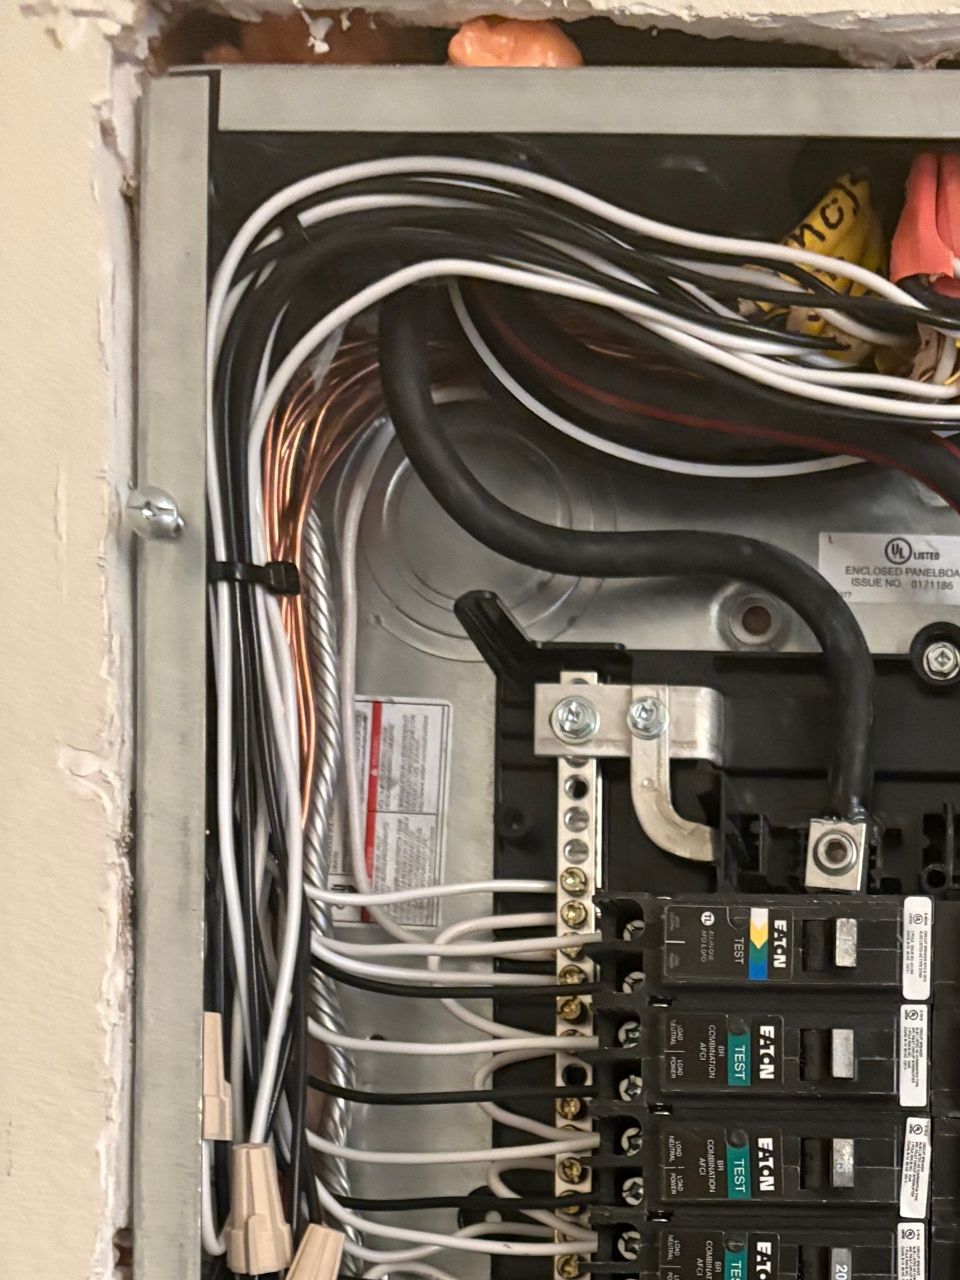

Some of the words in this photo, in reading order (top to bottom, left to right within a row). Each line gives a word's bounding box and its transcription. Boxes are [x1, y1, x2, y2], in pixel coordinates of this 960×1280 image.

[913, 551, 940, 561] LISTED
[845, 566, 903, 577] ENCLOSED
[851, 577, 882, 587] ISSUE
[734, 937, 745, 965] TEST
[773, 920, 787, 968] EATON
[708, 1024, 716, 1079] COMBINATION
[718, 1046, 725, 1057] BR
[734, 1045, 746, 1080] TEST
[759, 1025, 775, 1079] EATON
[707, 1139, 716, 1193] COMBINATION
[717, 1160, 724, 1171] BR
[733, 1158, 746, 1193] TEST
[758, 1137, 775, 1191] EATON
[714, 1261, 722, 1273] BR
[835, 1264, 848, 1280] 20
